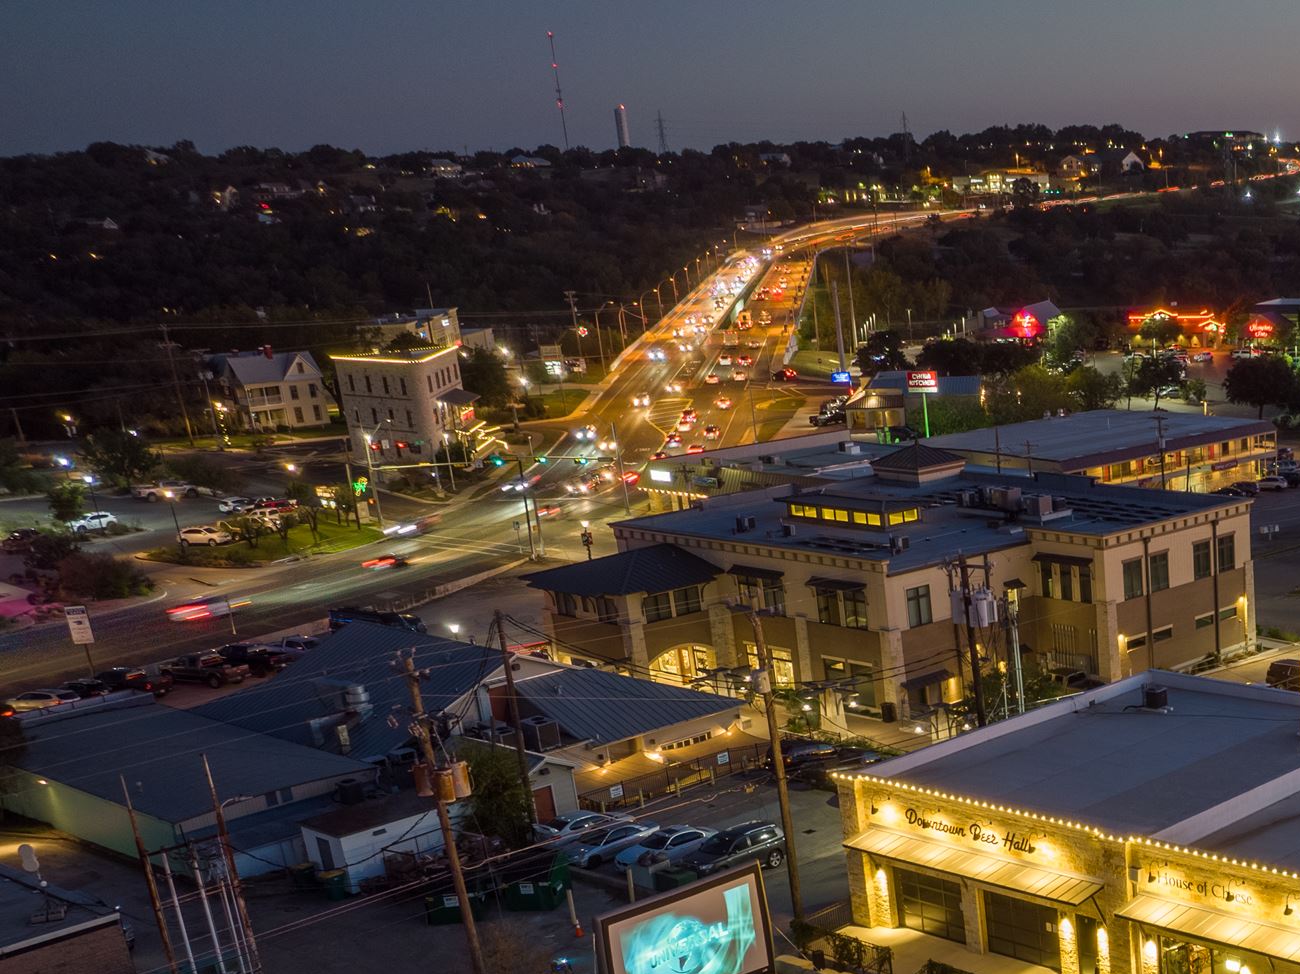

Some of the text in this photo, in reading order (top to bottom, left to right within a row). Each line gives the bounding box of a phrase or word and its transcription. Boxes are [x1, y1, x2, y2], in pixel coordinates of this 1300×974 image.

[969, 823, 999, 845] Beer
[1001, 831, 1029, 853] Hall
[1211, 884, 1253, 906] Chese
[650, 921, 730, 969] UNIVERSAL
